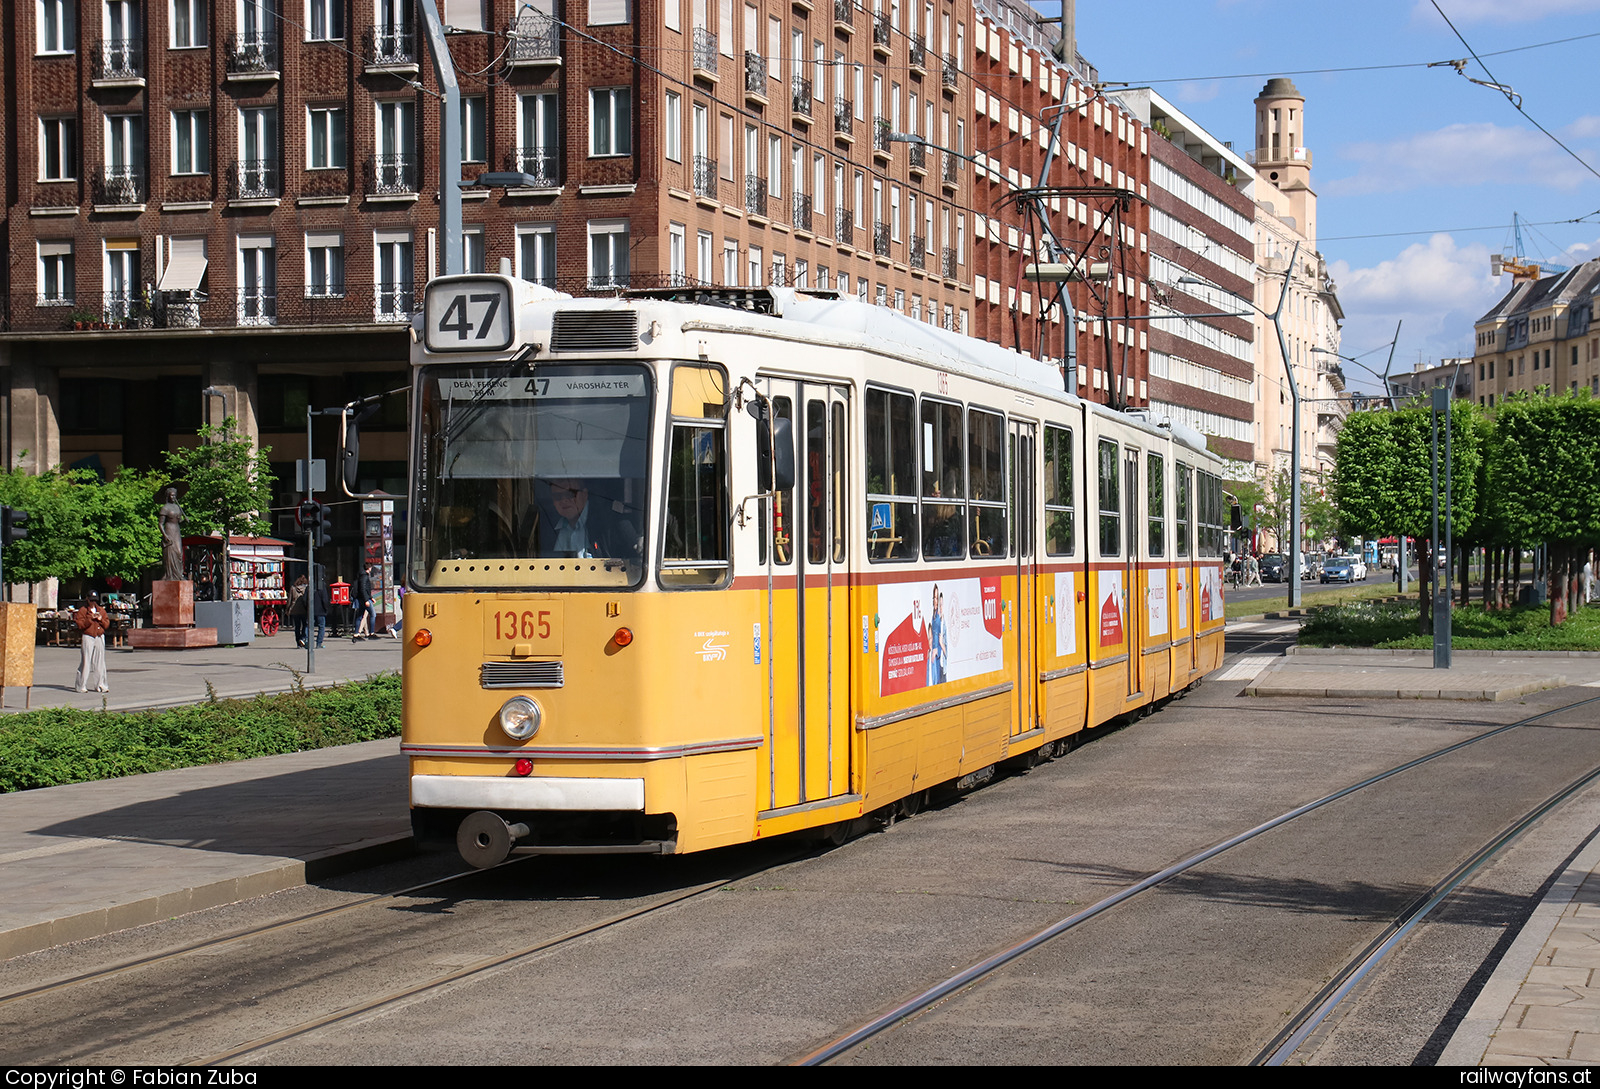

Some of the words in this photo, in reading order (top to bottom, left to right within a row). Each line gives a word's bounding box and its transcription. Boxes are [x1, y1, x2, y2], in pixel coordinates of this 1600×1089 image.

[438, 293, 501, 341] 47
[453, 379, 475, 389] DEÁK
[524, 378, 550, 396] 47
[566, 380, 612, 390] VÁROSHÁZ
[613, 379, 630, 390] TÉR
[913, 600, 922, 619] 1%
[494, 610, 551, 640] 1365
